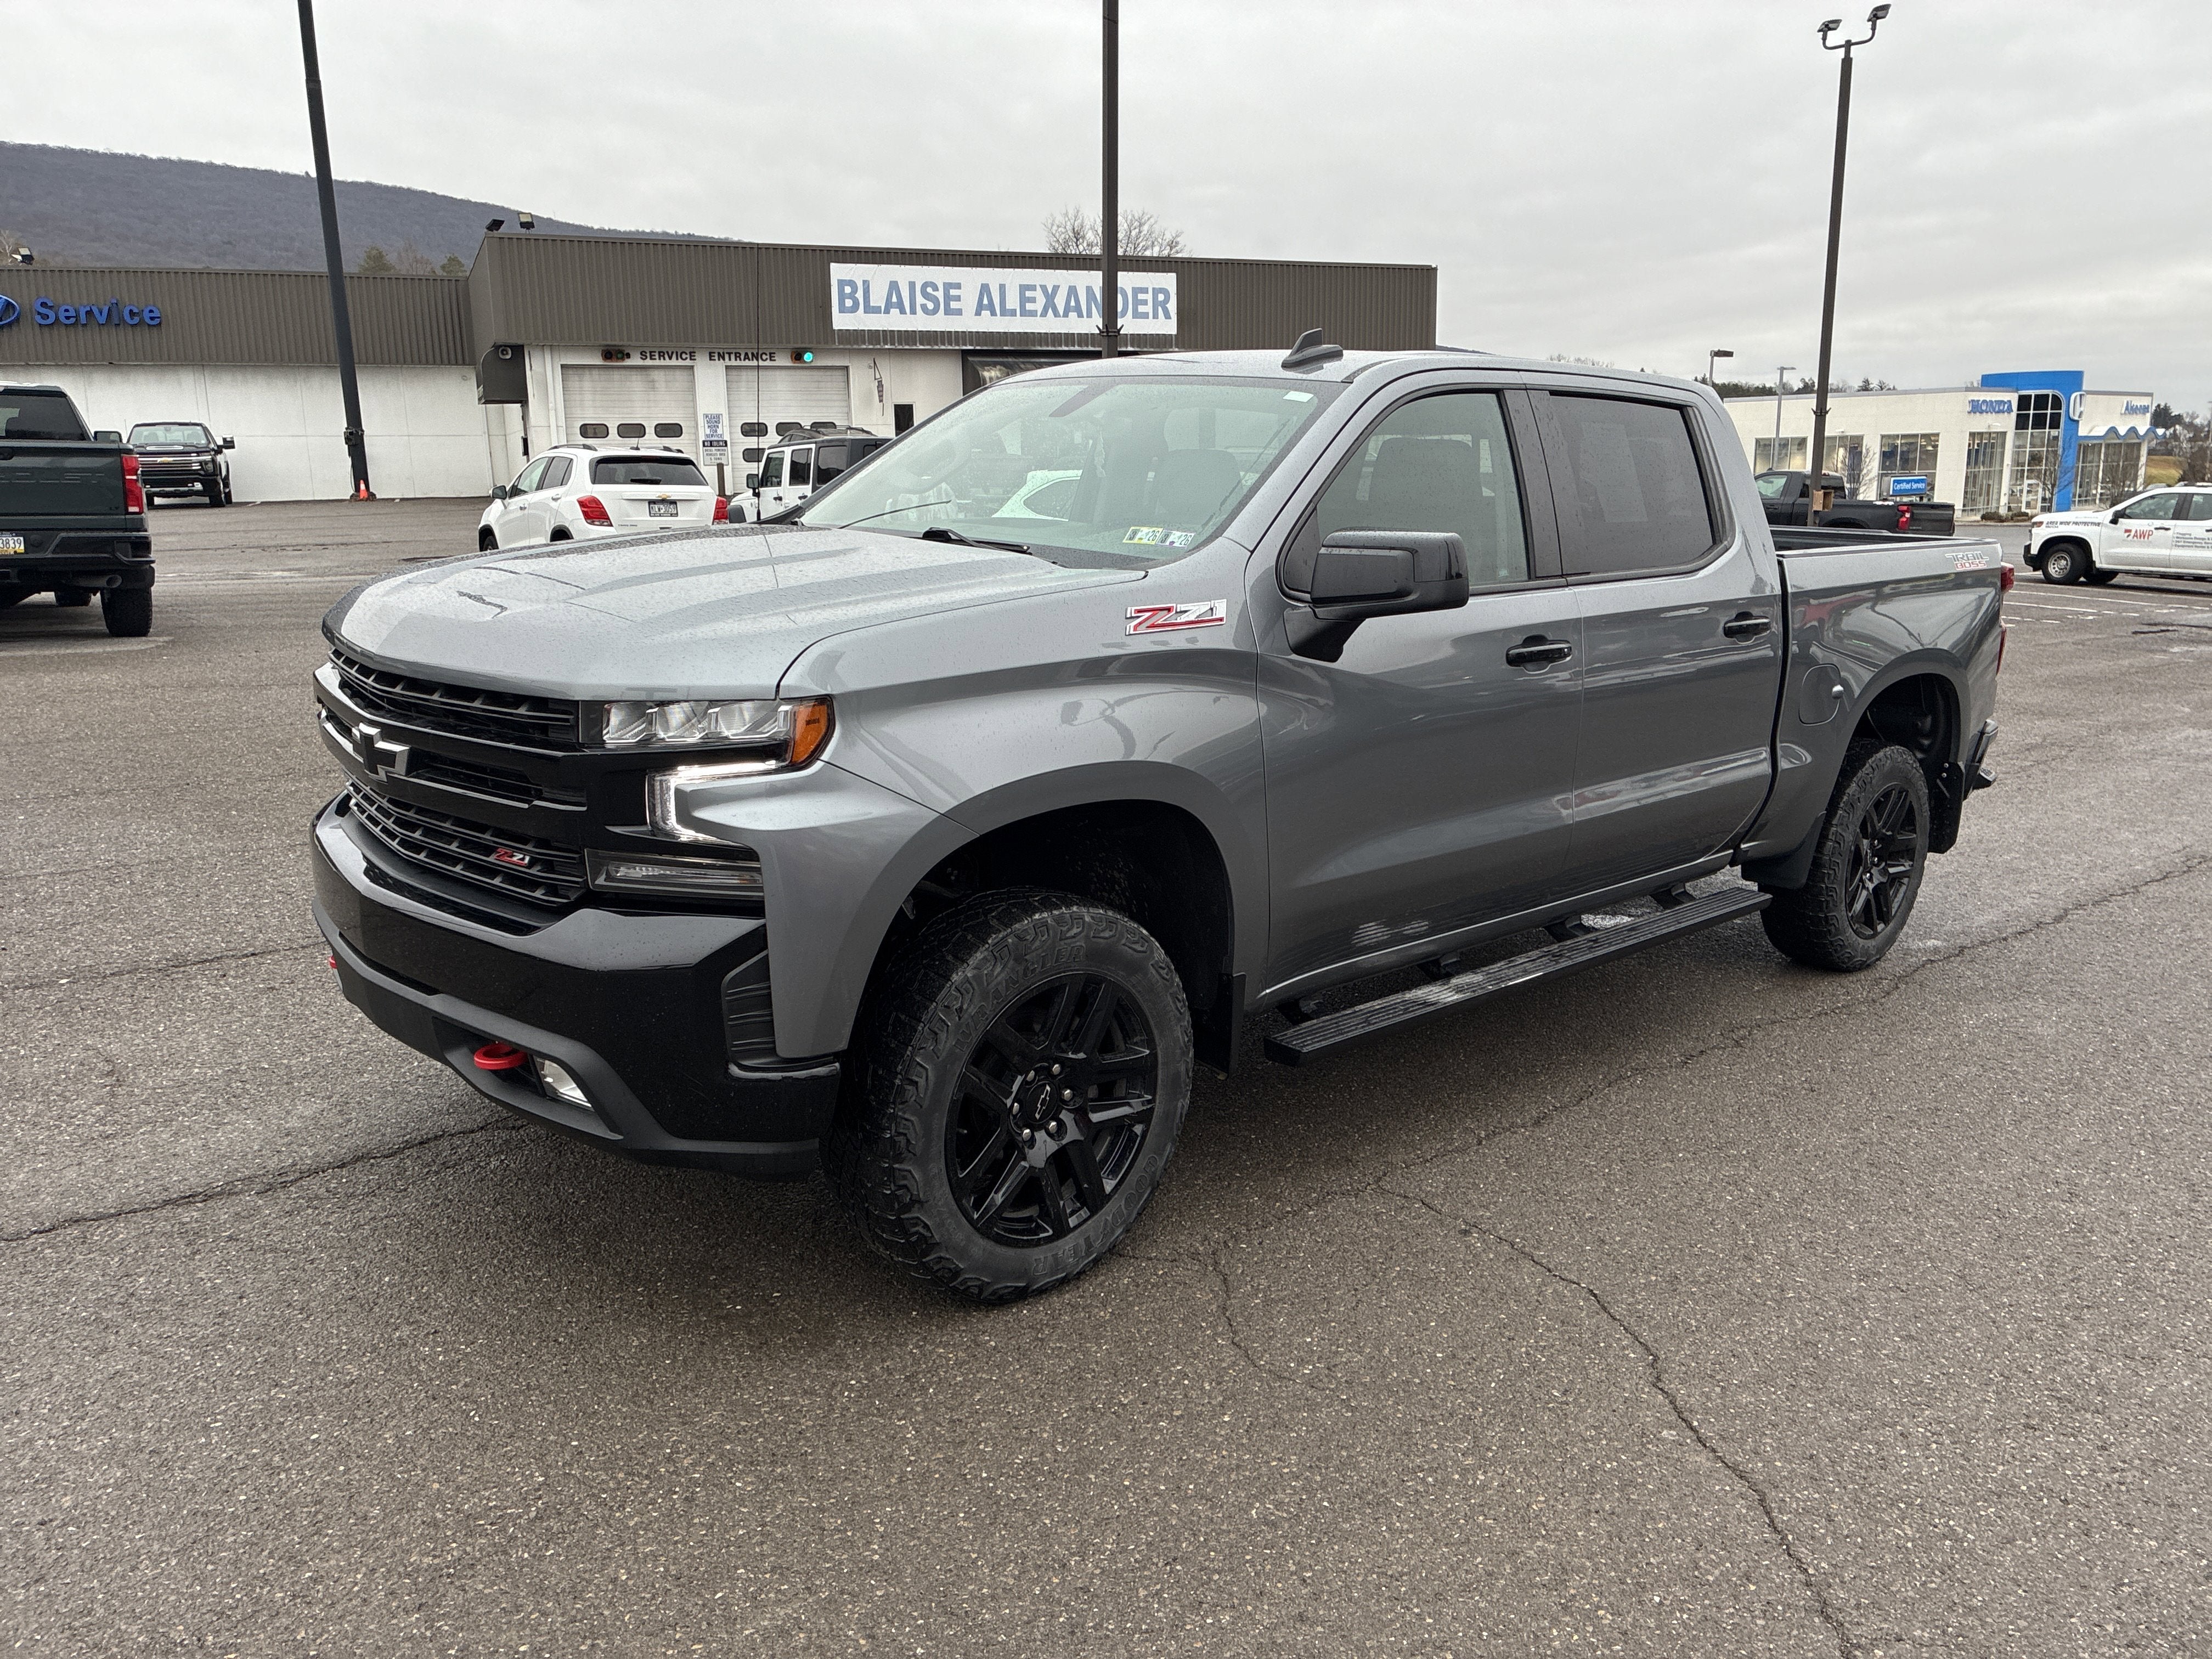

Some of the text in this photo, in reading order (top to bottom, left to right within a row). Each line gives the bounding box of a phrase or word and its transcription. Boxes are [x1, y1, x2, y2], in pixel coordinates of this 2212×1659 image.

[837, 279, 963, 316] BLAISE
[33, 296, 162, 325] Service
[640, 351, 777, 362] SERVICE ENTRANCE
[1967, 399, 2013, 414] HONDA
[1147, 530, 1160, 541] 26
[1179, 534, 1192, 546] 26
[2132, 529, 2154, 540] AWP
[0, 538, 22, 549] 3839
[1944, 551, 1990, 563] TRAIL
[1954, 560, 1987, 571] BOSS
[1125, 599, 1227, 636] Z71
[494, 848, 531, 866] Z71
